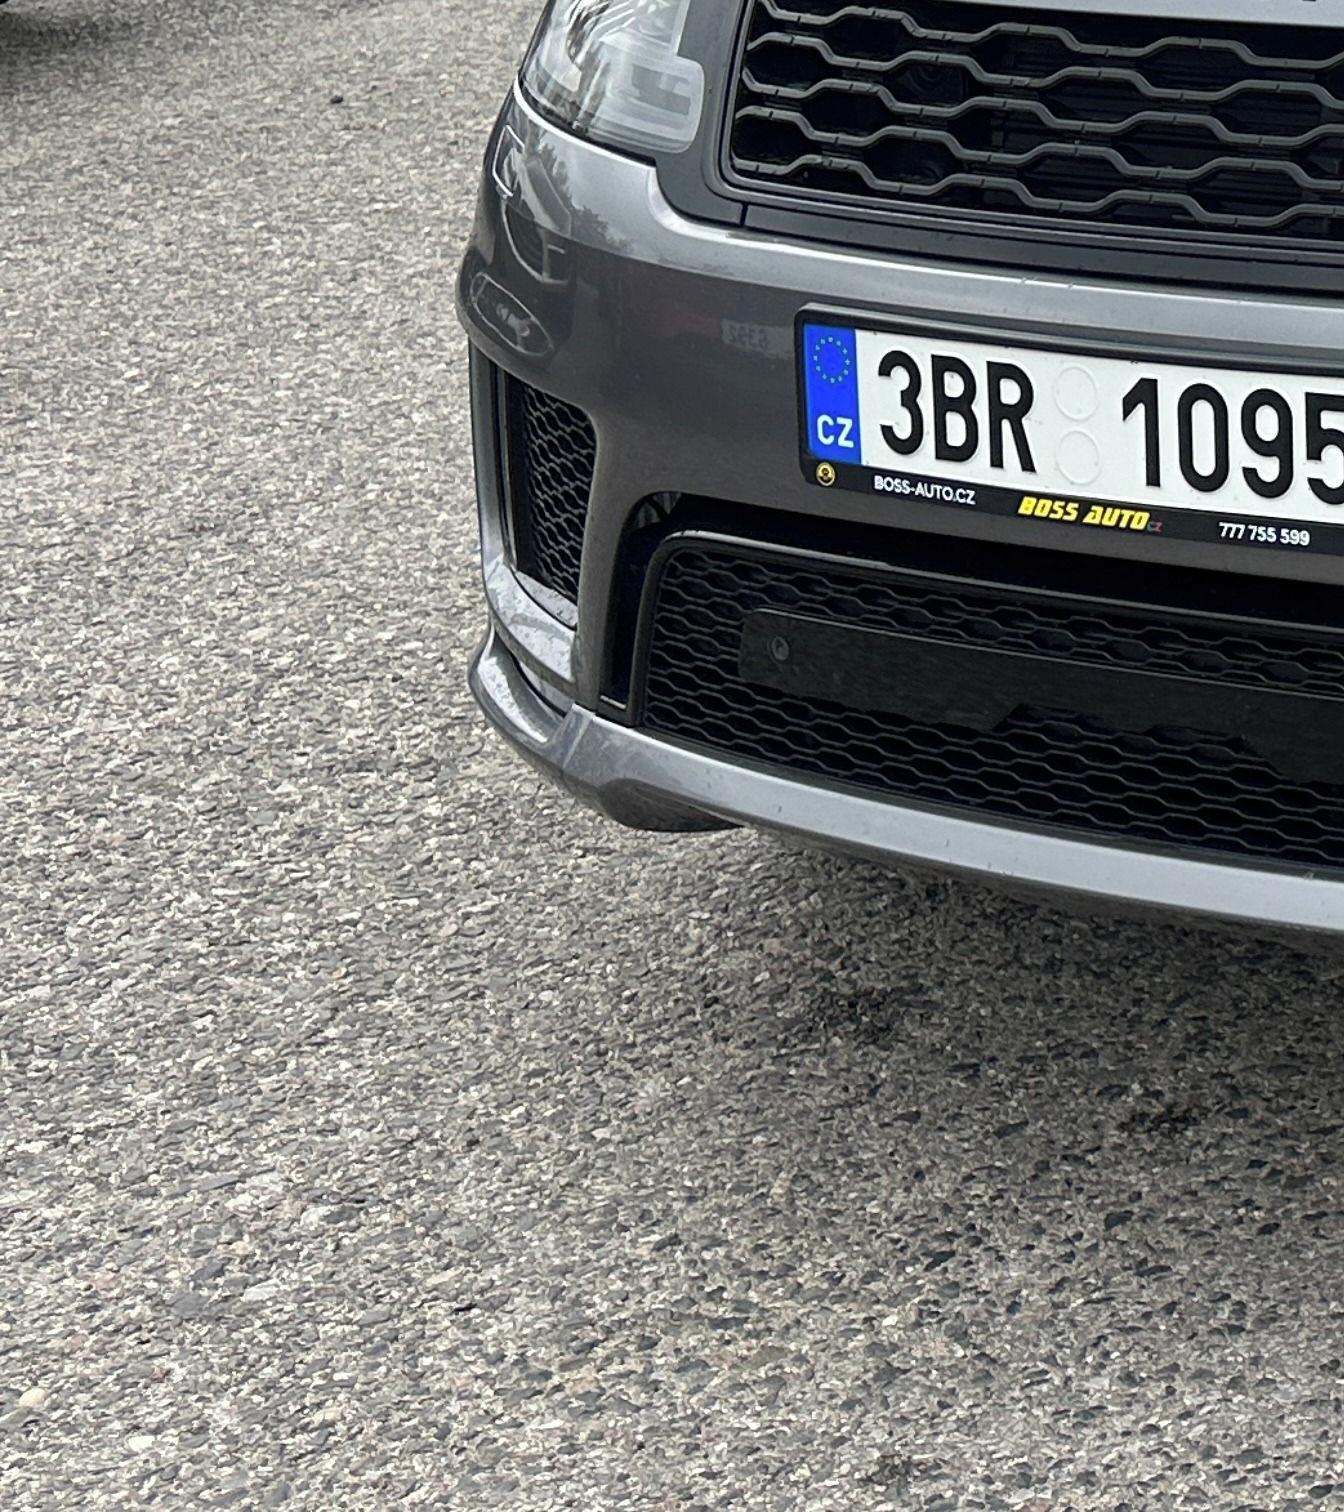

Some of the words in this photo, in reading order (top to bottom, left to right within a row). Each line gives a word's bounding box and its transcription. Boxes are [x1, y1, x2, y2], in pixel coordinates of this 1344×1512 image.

[878, 350, 1038, 473] 3BR
[816, 414, 854, 448] CZ
[874, 475, 976, 505] BOSS-AUTO.CZ
[1018, 495, 1079, 522] BOSS
[1082, 504, 1151, 531] AUTO
[1218, 521, 1247, 539] 777
[1248, 524, 1276, 544] 755
[1279, 527, 1310, 546] 599
